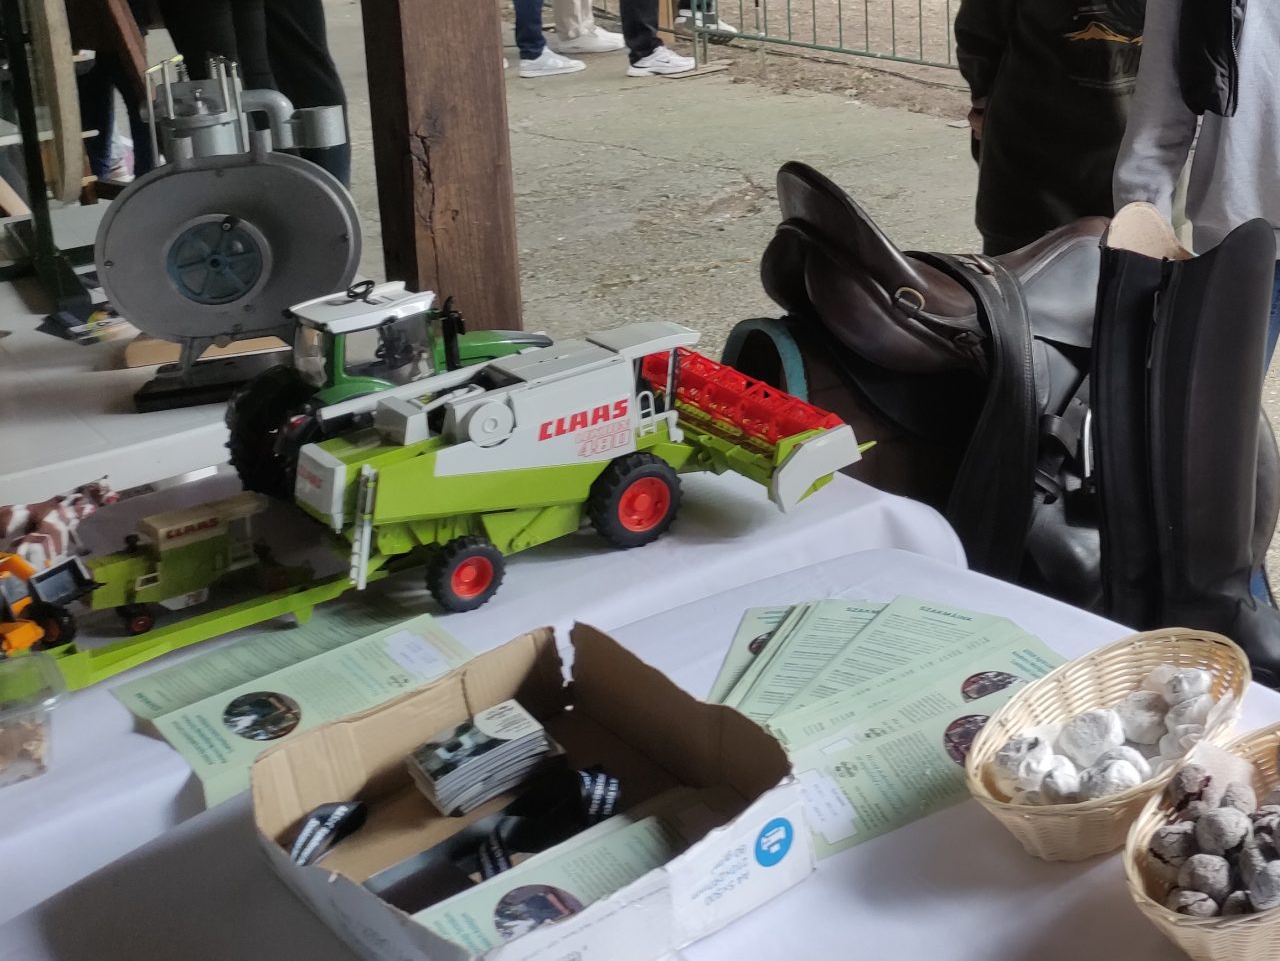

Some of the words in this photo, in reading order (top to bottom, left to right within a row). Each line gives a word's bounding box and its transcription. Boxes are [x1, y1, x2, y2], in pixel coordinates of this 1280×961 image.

[538, 399, 628, 441] CLAAS
[578, 429, 631, 457] 480
[166, 517, 219, 539] CLAAS
